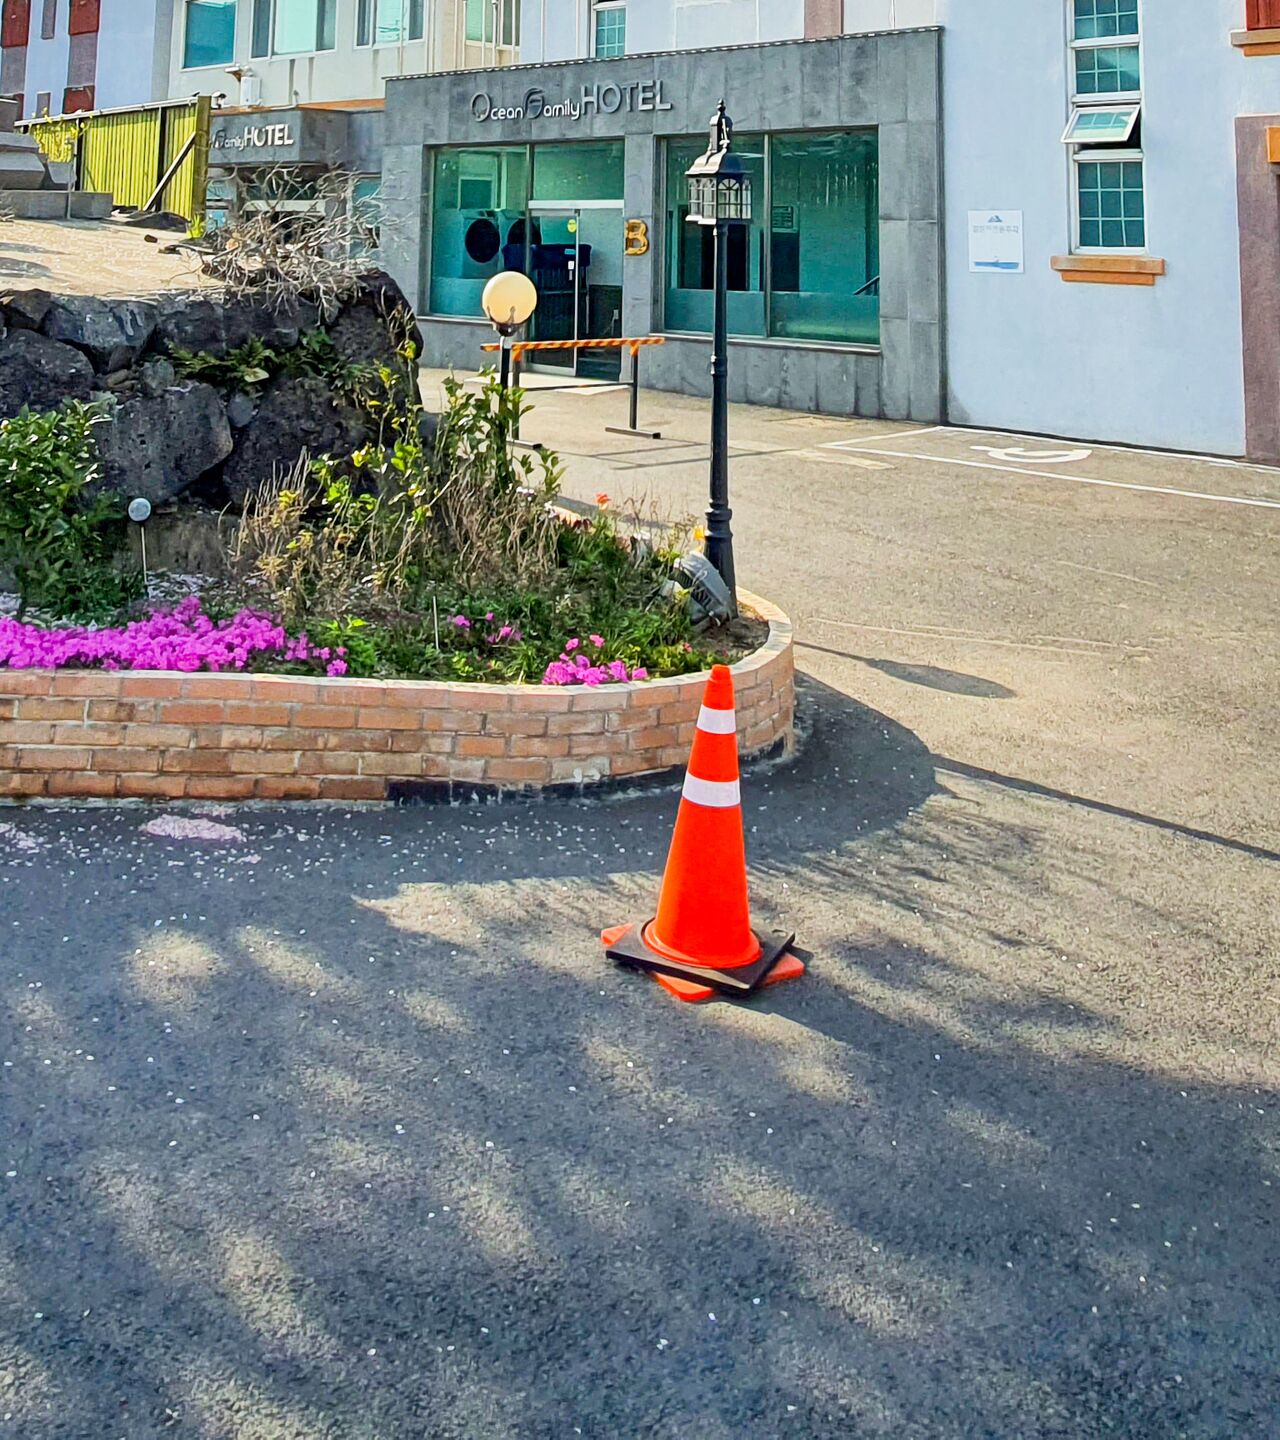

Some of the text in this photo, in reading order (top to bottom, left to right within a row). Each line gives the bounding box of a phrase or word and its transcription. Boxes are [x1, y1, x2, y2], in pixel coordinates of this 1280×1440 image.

[471, 91, 523, 122] Ocean
[580, 79, 672, 114] HOTEL
[244, 123, 294, 147] HOTEL
[624, 219, 650, 256] B
